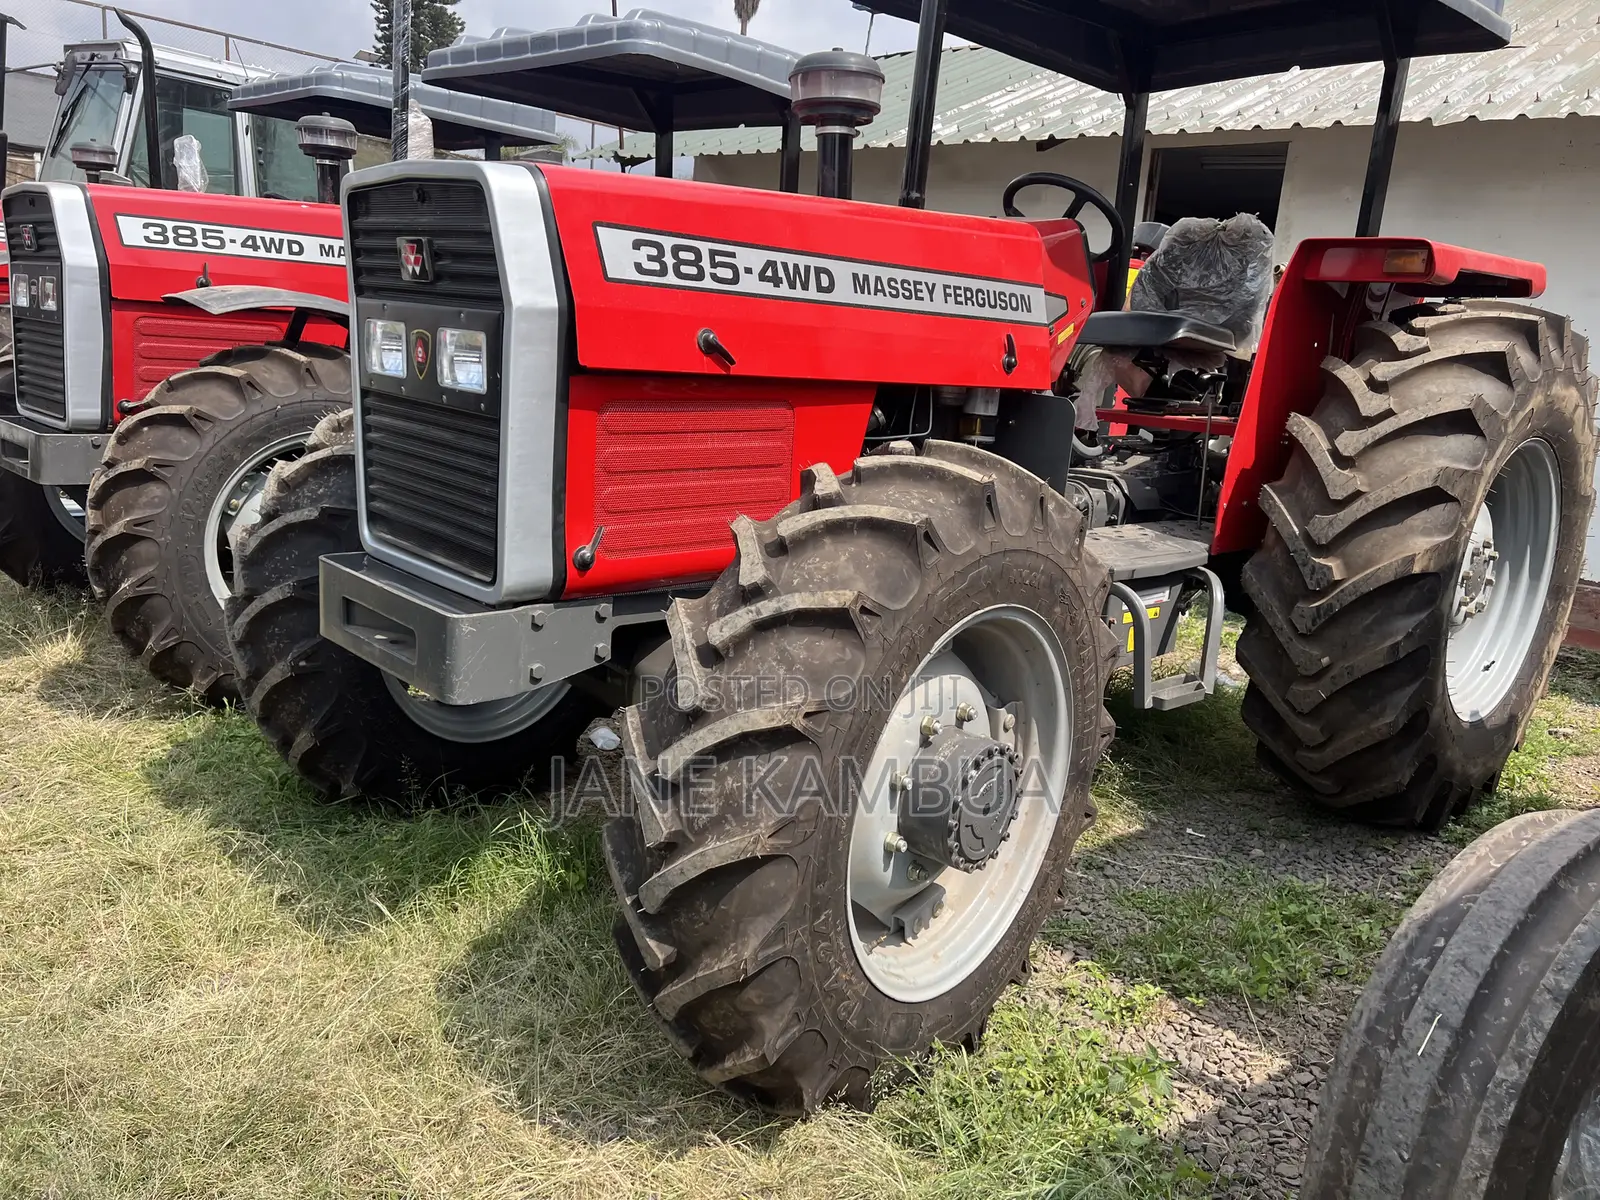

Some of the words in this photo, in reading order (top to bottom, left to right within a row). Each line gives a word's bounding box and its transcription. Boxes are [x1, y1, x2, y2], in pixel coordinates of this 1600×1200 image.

[142, 223, 305, 256] 385-4WD
[632, 239, 836, 294] 385-4WD
[852, 275, 938, 303] MASSEY
[942, 285, 1033, 314] FERGUSON
